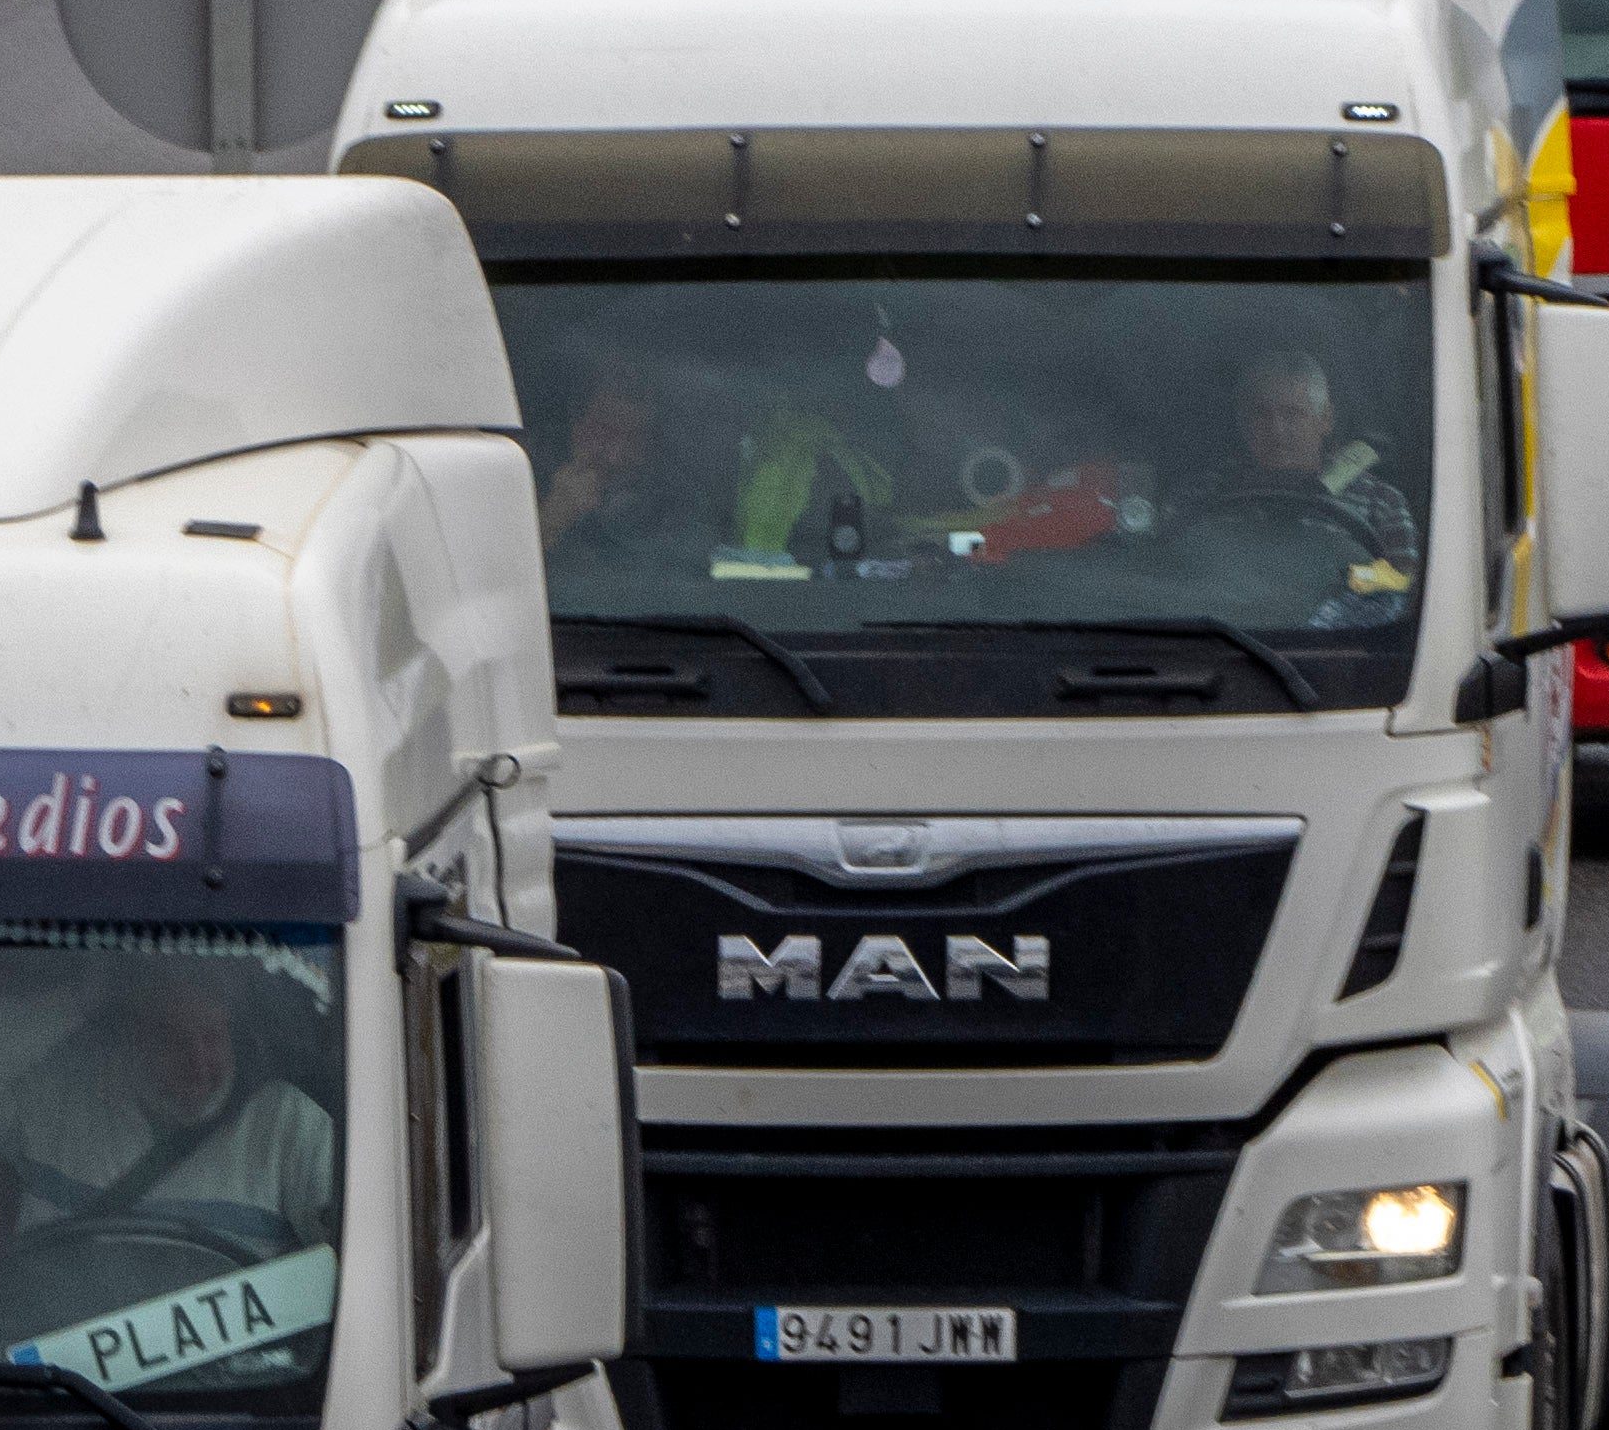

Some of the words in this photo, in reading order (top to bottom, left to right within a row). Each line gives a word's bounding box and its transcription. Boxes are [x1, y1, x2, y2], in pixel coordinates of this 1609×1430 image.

[717, 934, 1051, 1000] MAN
[86, 1279, 276, 1385] PLATA
[781, 1313, 905, 1356] 9491
